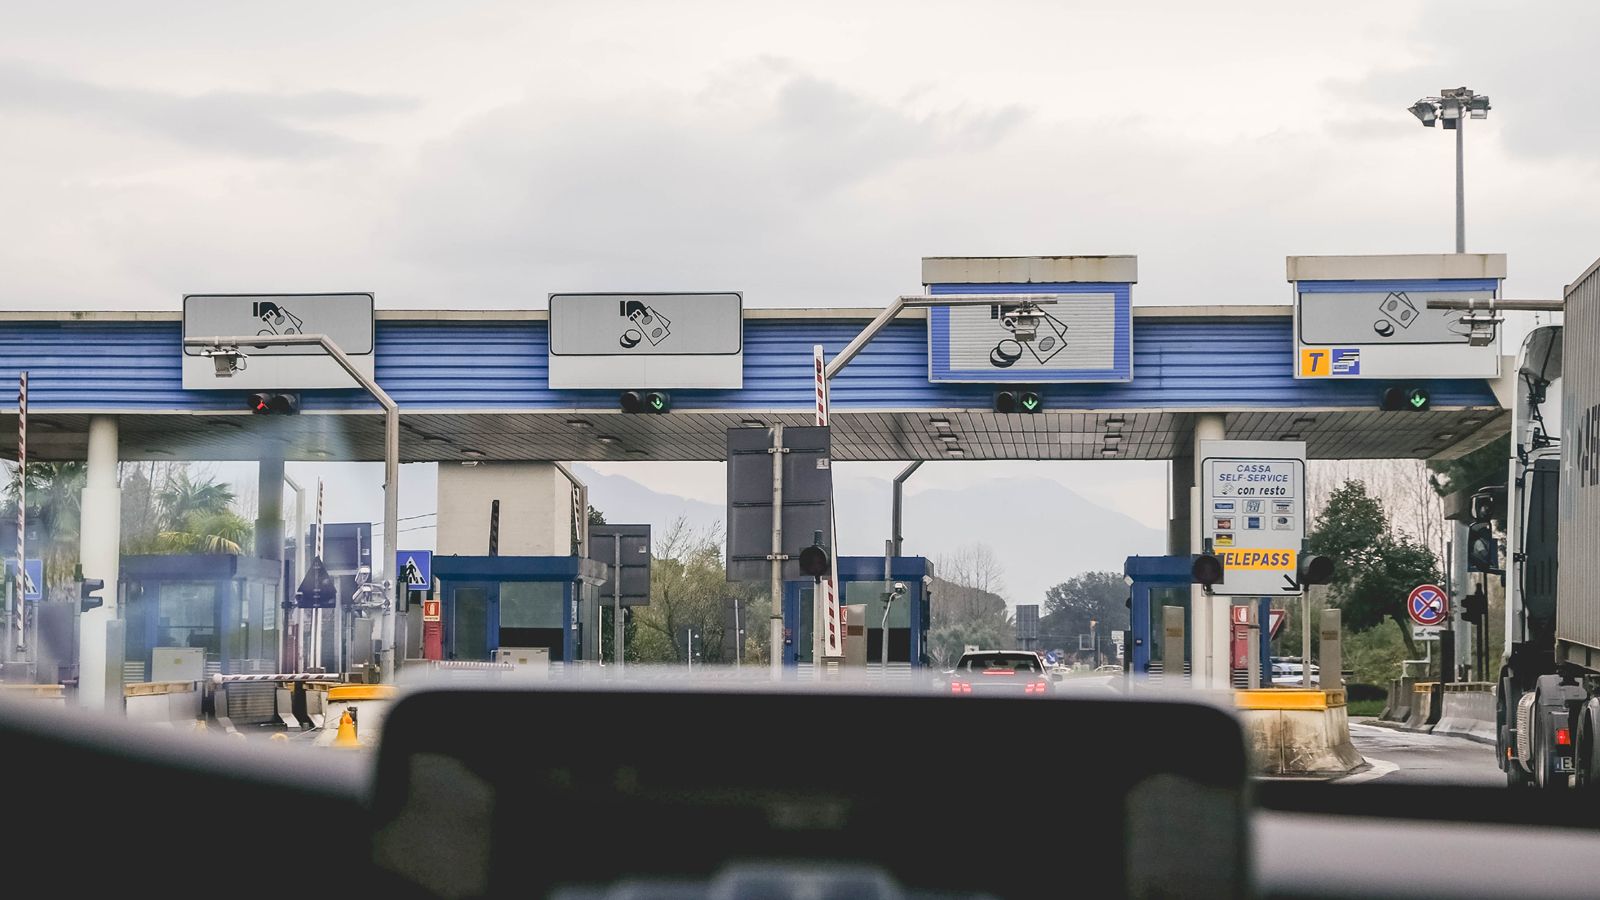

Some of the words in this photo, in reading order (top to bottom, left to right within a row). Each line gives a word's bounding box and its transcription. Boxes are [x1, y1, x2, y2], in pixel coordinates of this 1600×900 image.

[1309, 353, 1324, 372] T
[1236, 464, 1271, 473] CASSA
[1219, 473, 1288, 482] SELF-SERVICE
[1237, 486, 1255, 496] con
[1259, 485, 1286, 496] resto
